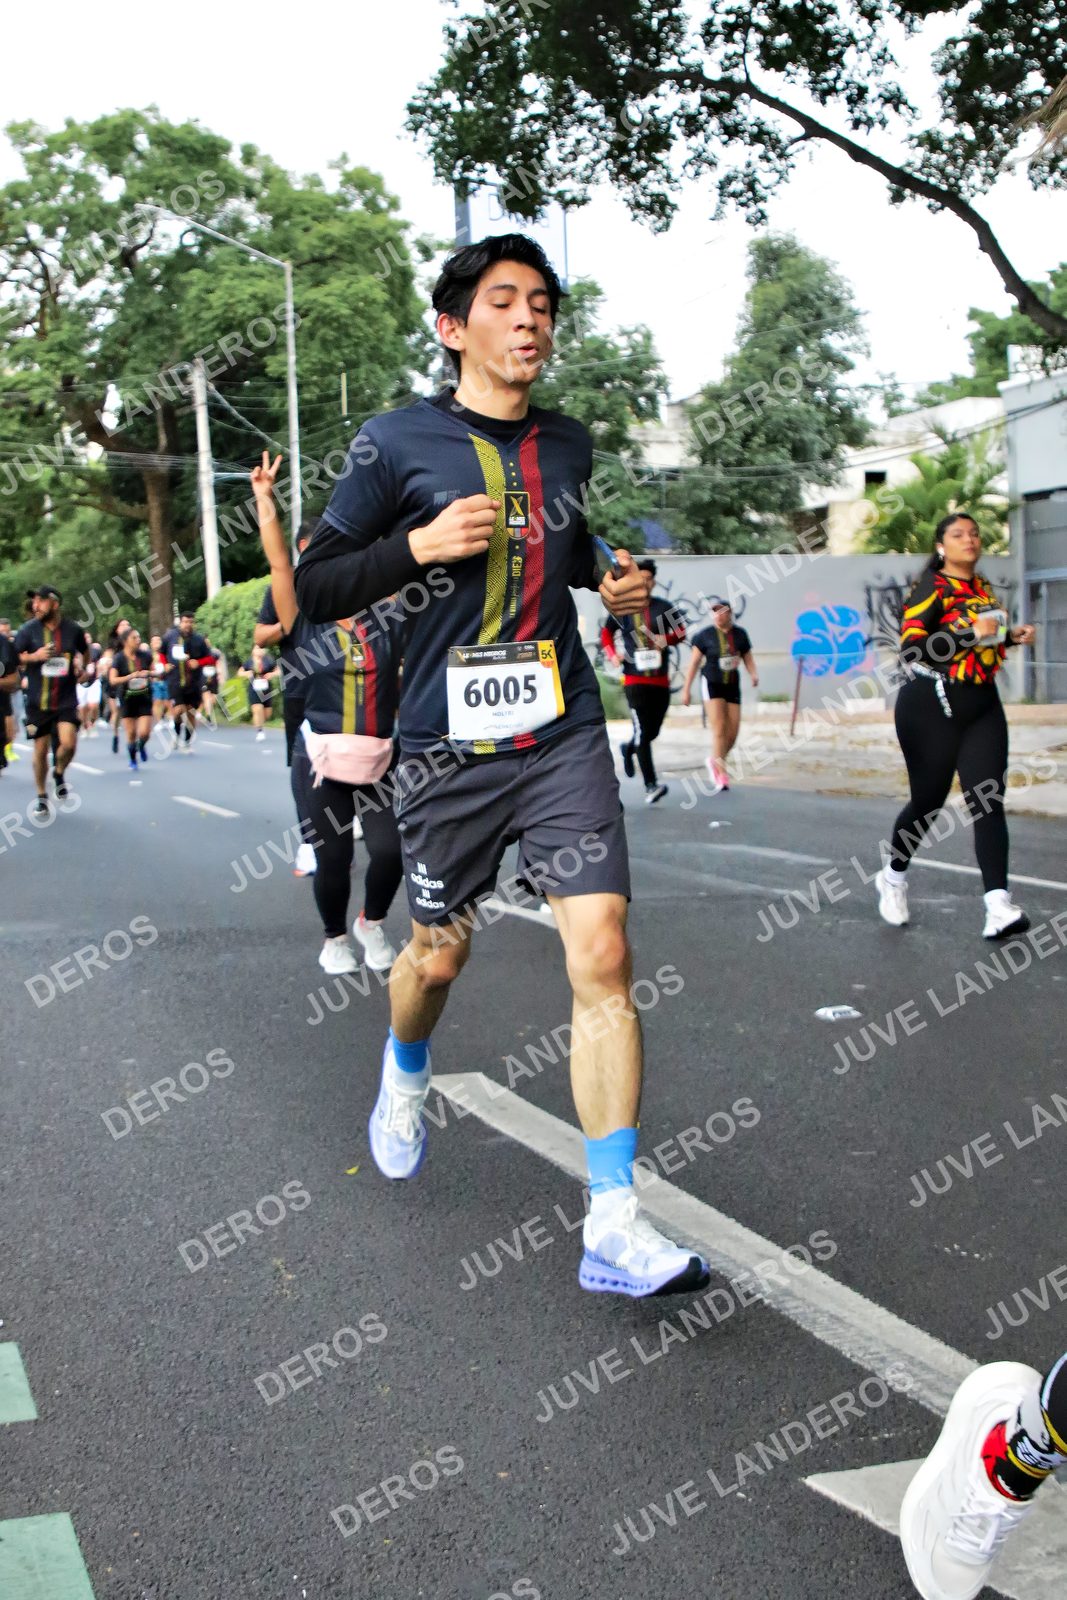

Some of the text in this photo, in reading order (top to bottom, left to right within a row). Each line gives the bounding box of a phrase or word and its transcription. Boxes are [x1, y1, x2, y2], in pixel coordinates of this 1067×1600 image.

[464, 674, 538, 708] 6005
[411, 873, 445, 889] adidas
[416, 897, 446, 909] adidas
